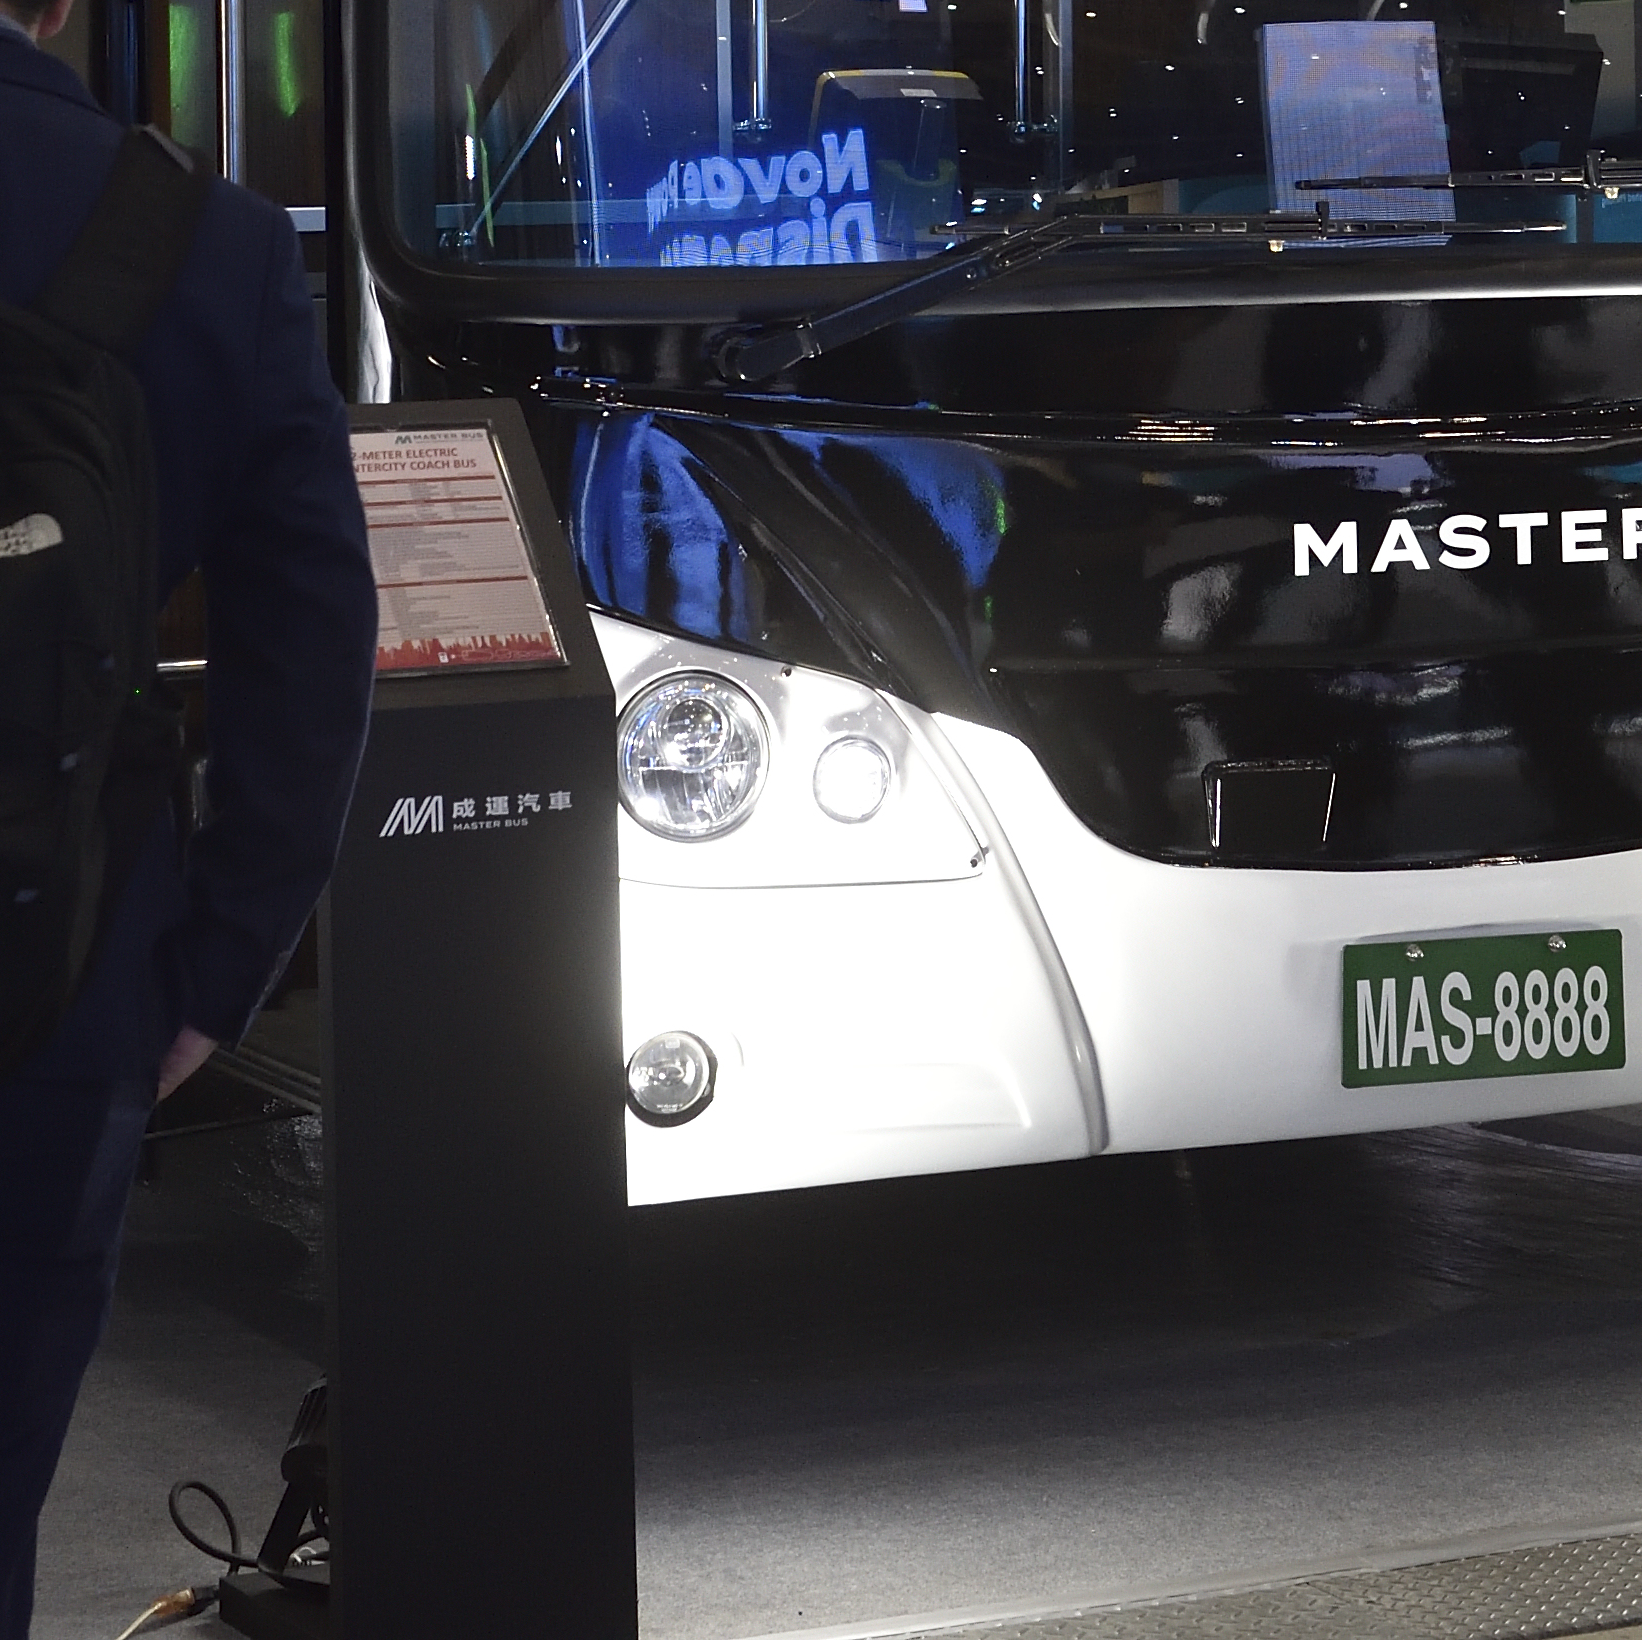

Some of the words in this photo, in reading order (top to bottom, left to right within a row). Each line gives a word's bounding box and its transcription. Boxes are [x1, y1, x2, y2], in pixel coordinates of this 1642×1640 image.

[413, 432, 458, 442] MASTER
[461, 431, 484, 440] BUS
[406, 446, 458, 459] ELECTRIC
[410, 459, 453, 471] COACH
[454, 458, 477, 469] BUS
[452, 790, 573, 819] 成運汽車
[453, 818, 501, 832] MASTER
[504, 817, 529, 828] BUS
[1357, 965, 1611, 1070] MAS-8888
